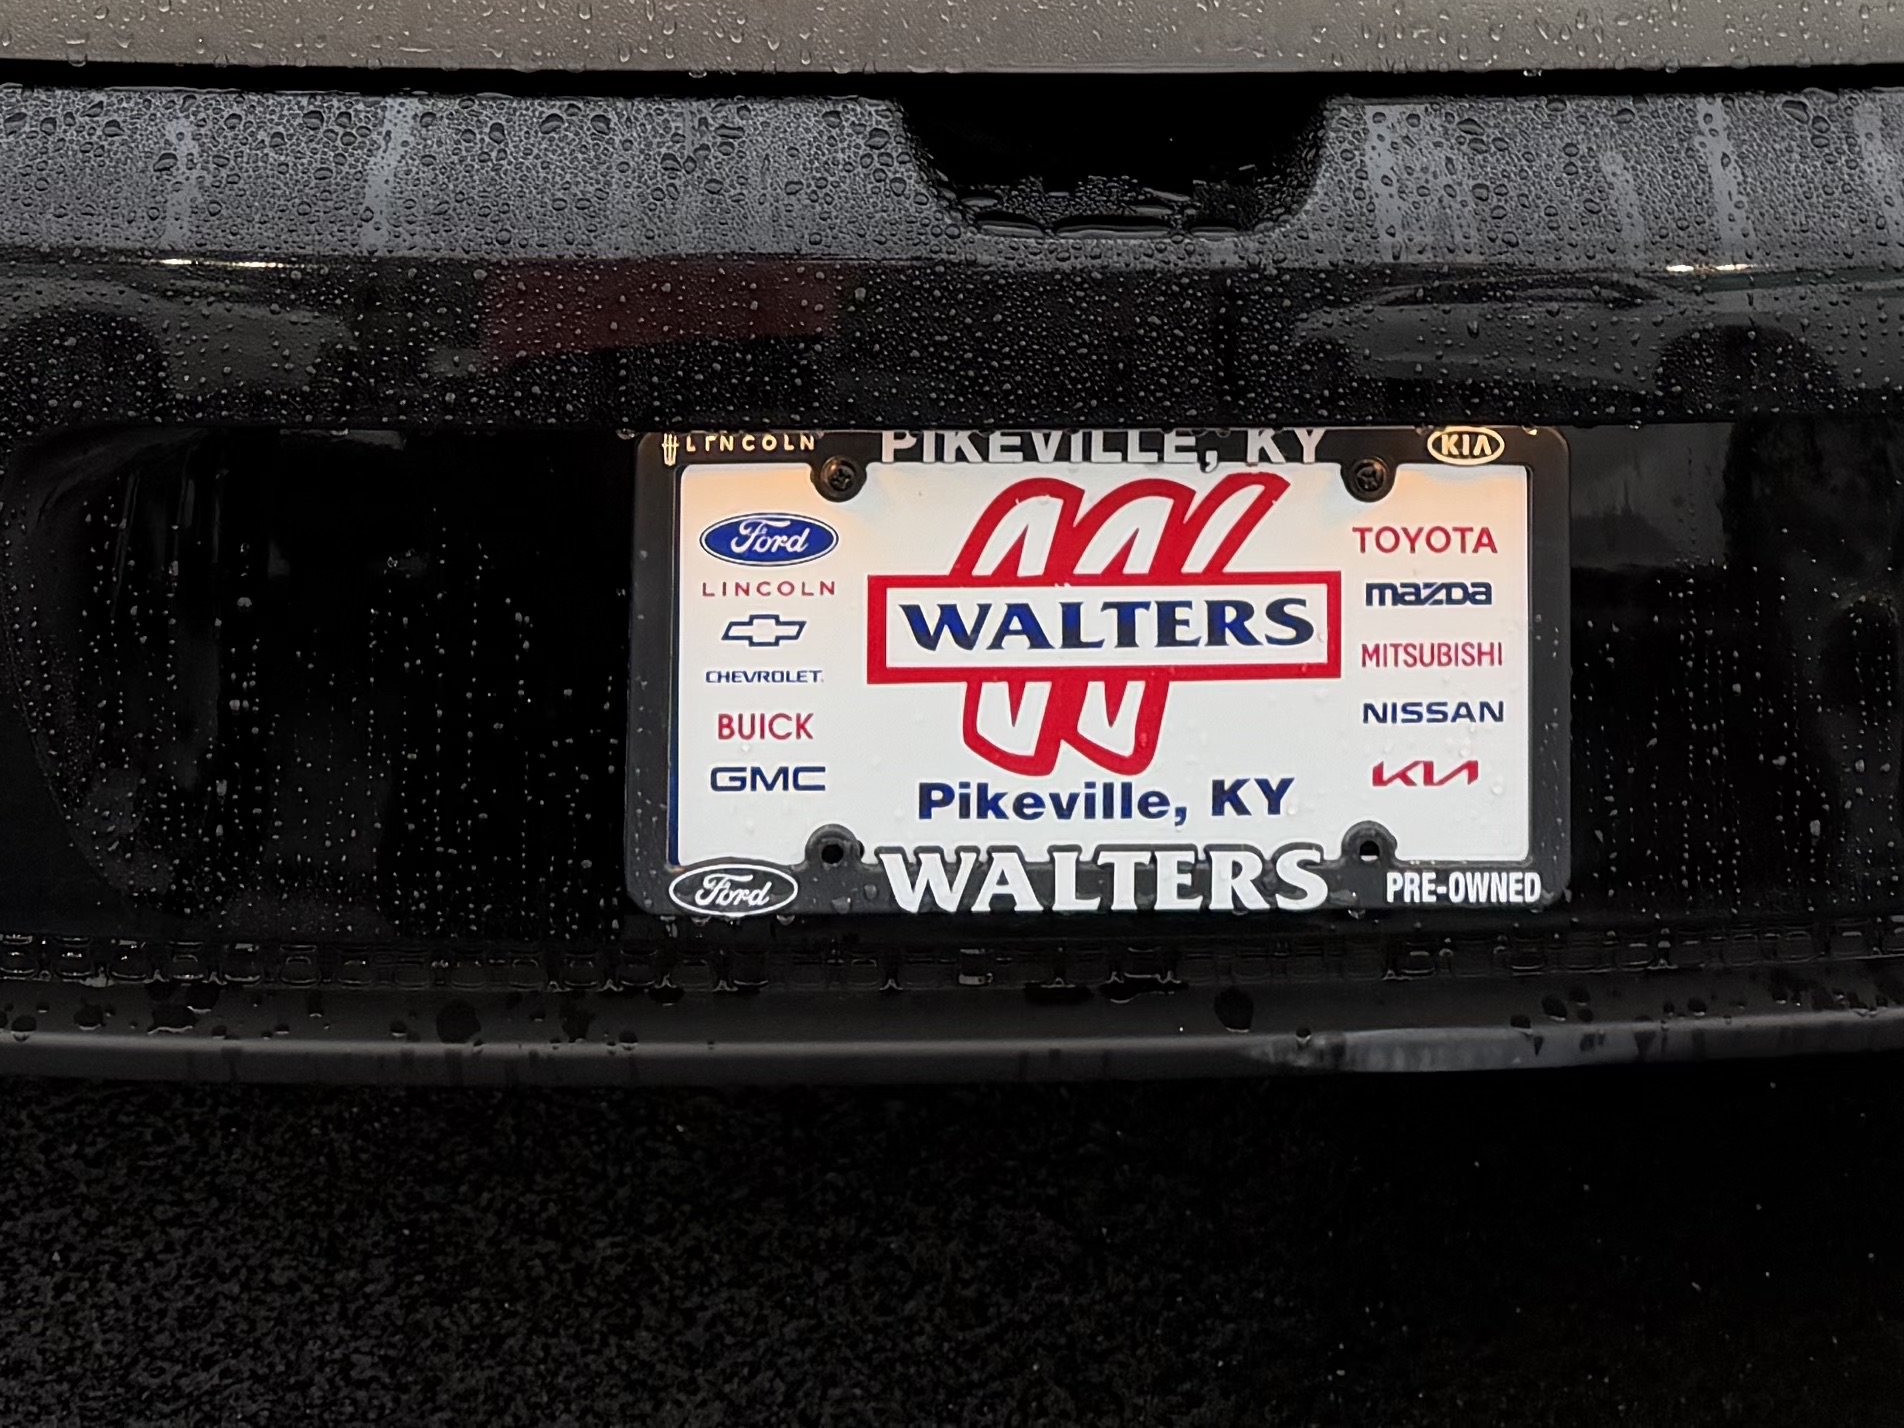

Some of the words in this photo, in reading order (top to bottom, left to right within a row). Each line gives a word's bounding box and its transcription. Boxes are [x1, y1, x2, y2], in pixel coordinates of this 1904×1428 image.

[685, 432, 816, 452] LINCOLN
[880, 428, 1219, 474] PIKEVILLE,
[1246, 428, 1327, 464] KY
[1440, 434, 1493, 457] KIA
[729, 518, 811, 554] Ford
[1352, 525, 1499, 555] TOYOTA
[702, 580, 835, 597] LINCOLN
[1365, 581, 1493, 607] mazda
[899, 596, 1317, 651] WALTERS
[1361, 641, 1503, 668] MITSUBISHI
[705, 669, 823, 684] CHEVROLET
[1362, 700, 1504, 724] NISSAN
[717, 712, 815, 740] BUICK
[710, 766, 827, 792] GMC
[1372, 760, 1479, 787] KIA
[918, 781, 1188, 826] Pikeville,
[1211, 777, 1295, 817] KY
[694, 872, 773, 907] Ford
[879, 849, 1330, 914] WALTERS
[1385, 871, 1542, 904] PRE-OWNED
